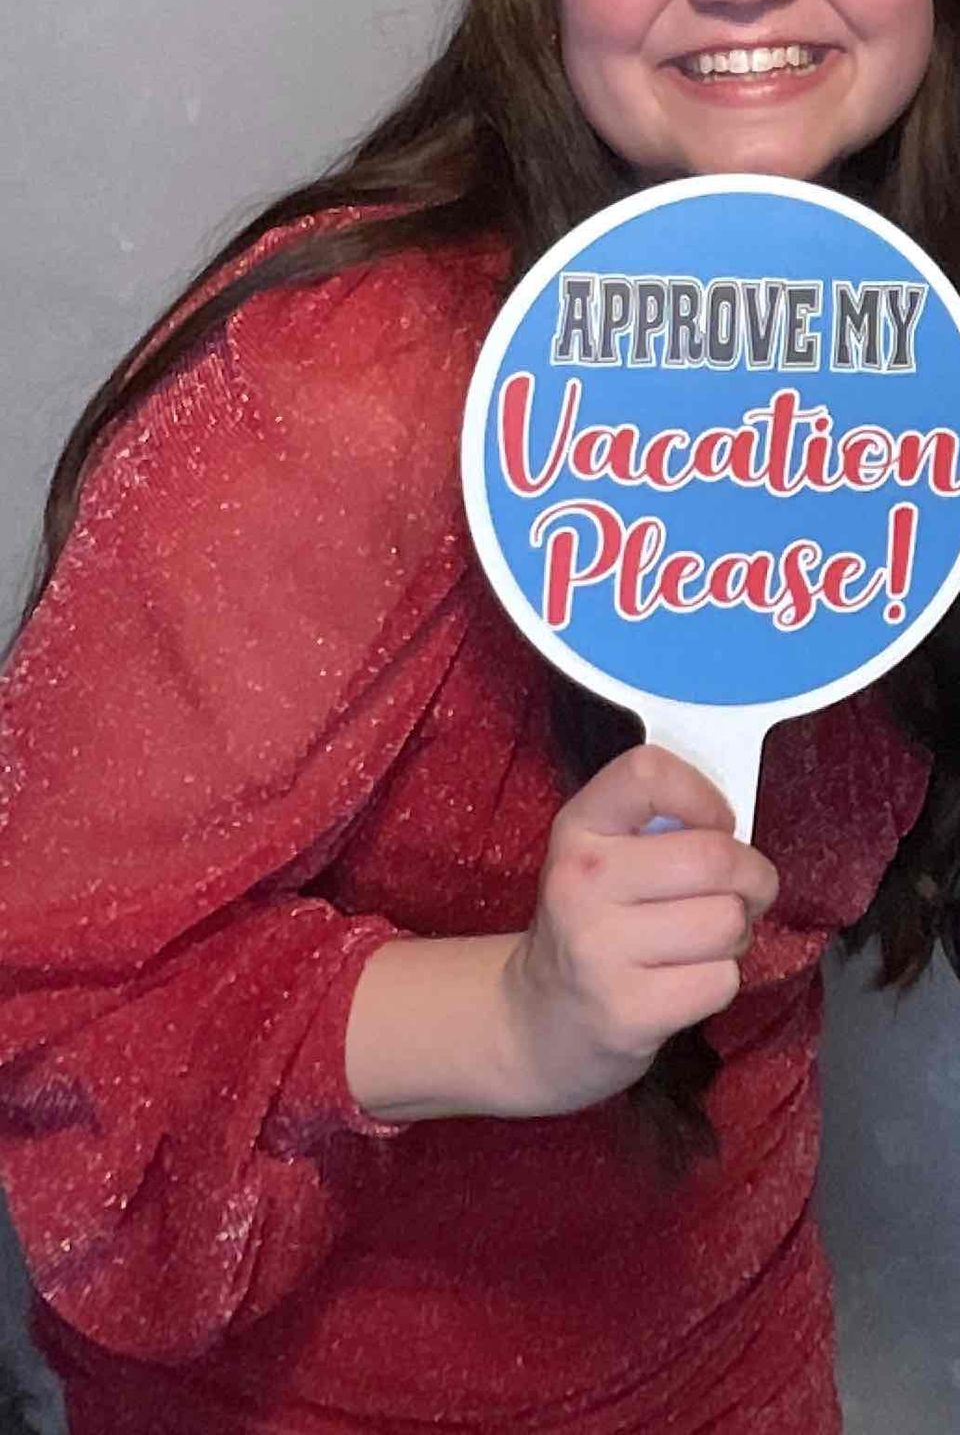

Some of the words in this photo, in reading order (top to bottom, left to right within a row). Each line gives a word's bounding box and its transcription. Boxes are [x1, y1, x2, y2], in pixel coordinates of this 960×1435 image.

[552, 272, 822, 372] APPROVE
[831, 280, 929, 373] MY
[530, 499, 917, 631] Please!
